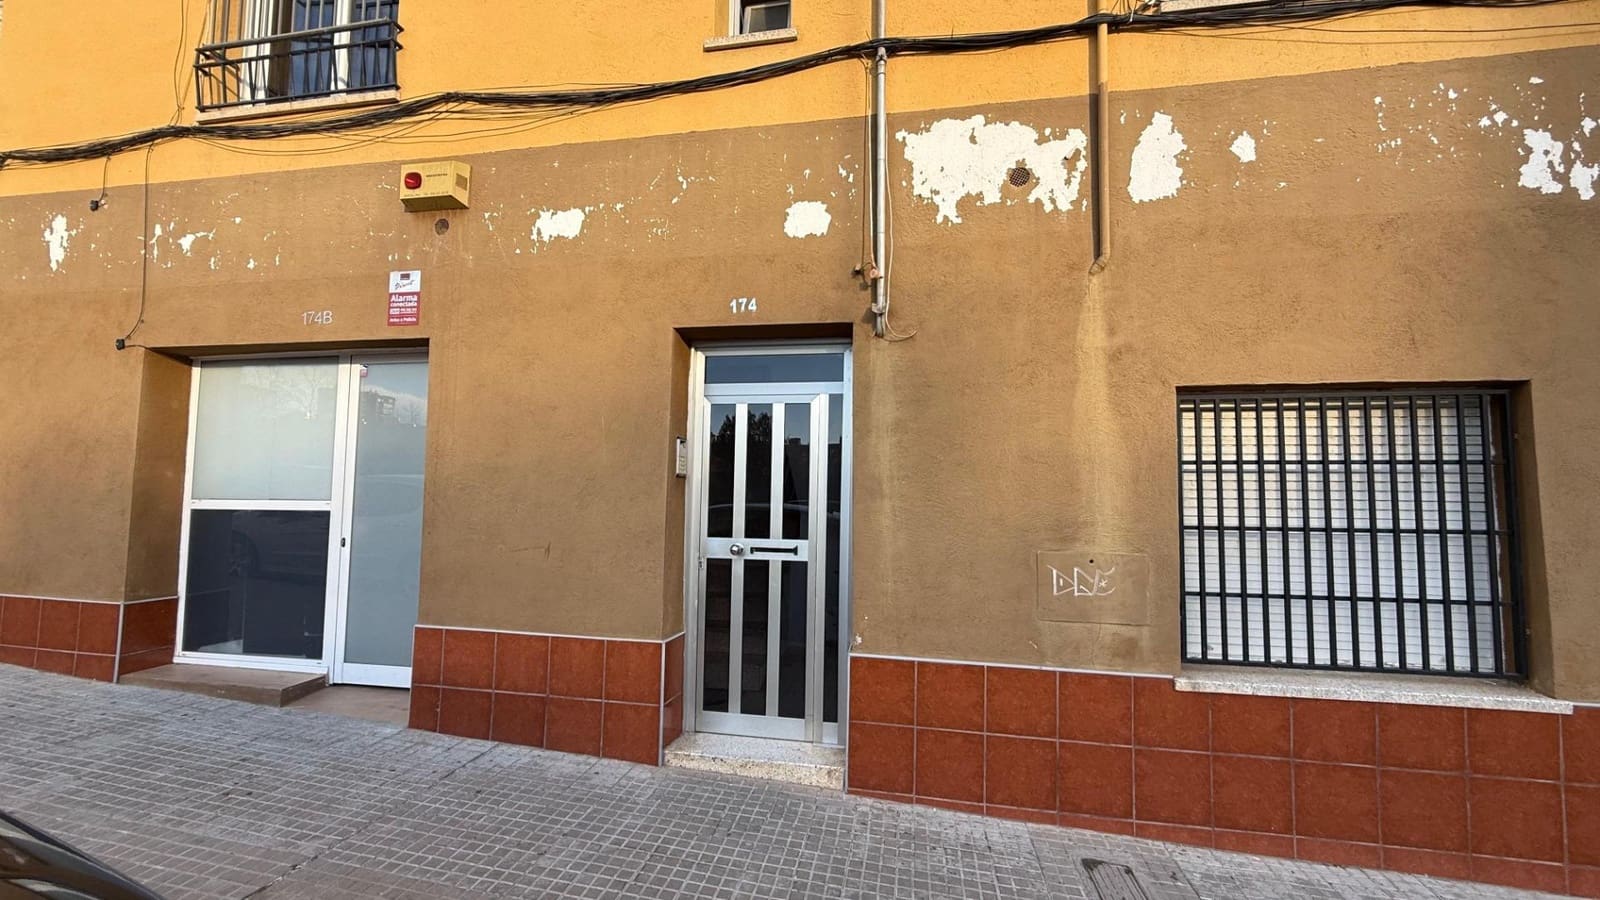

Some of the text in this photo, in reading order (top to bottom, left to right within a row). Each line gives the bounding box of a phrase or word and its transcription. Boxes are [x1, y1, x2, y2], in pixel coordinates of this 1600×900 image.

[390, 293, 418, 302] Alarma
[729, 297, 757, 313] 174
[302, 310, 333, 325] 174B
